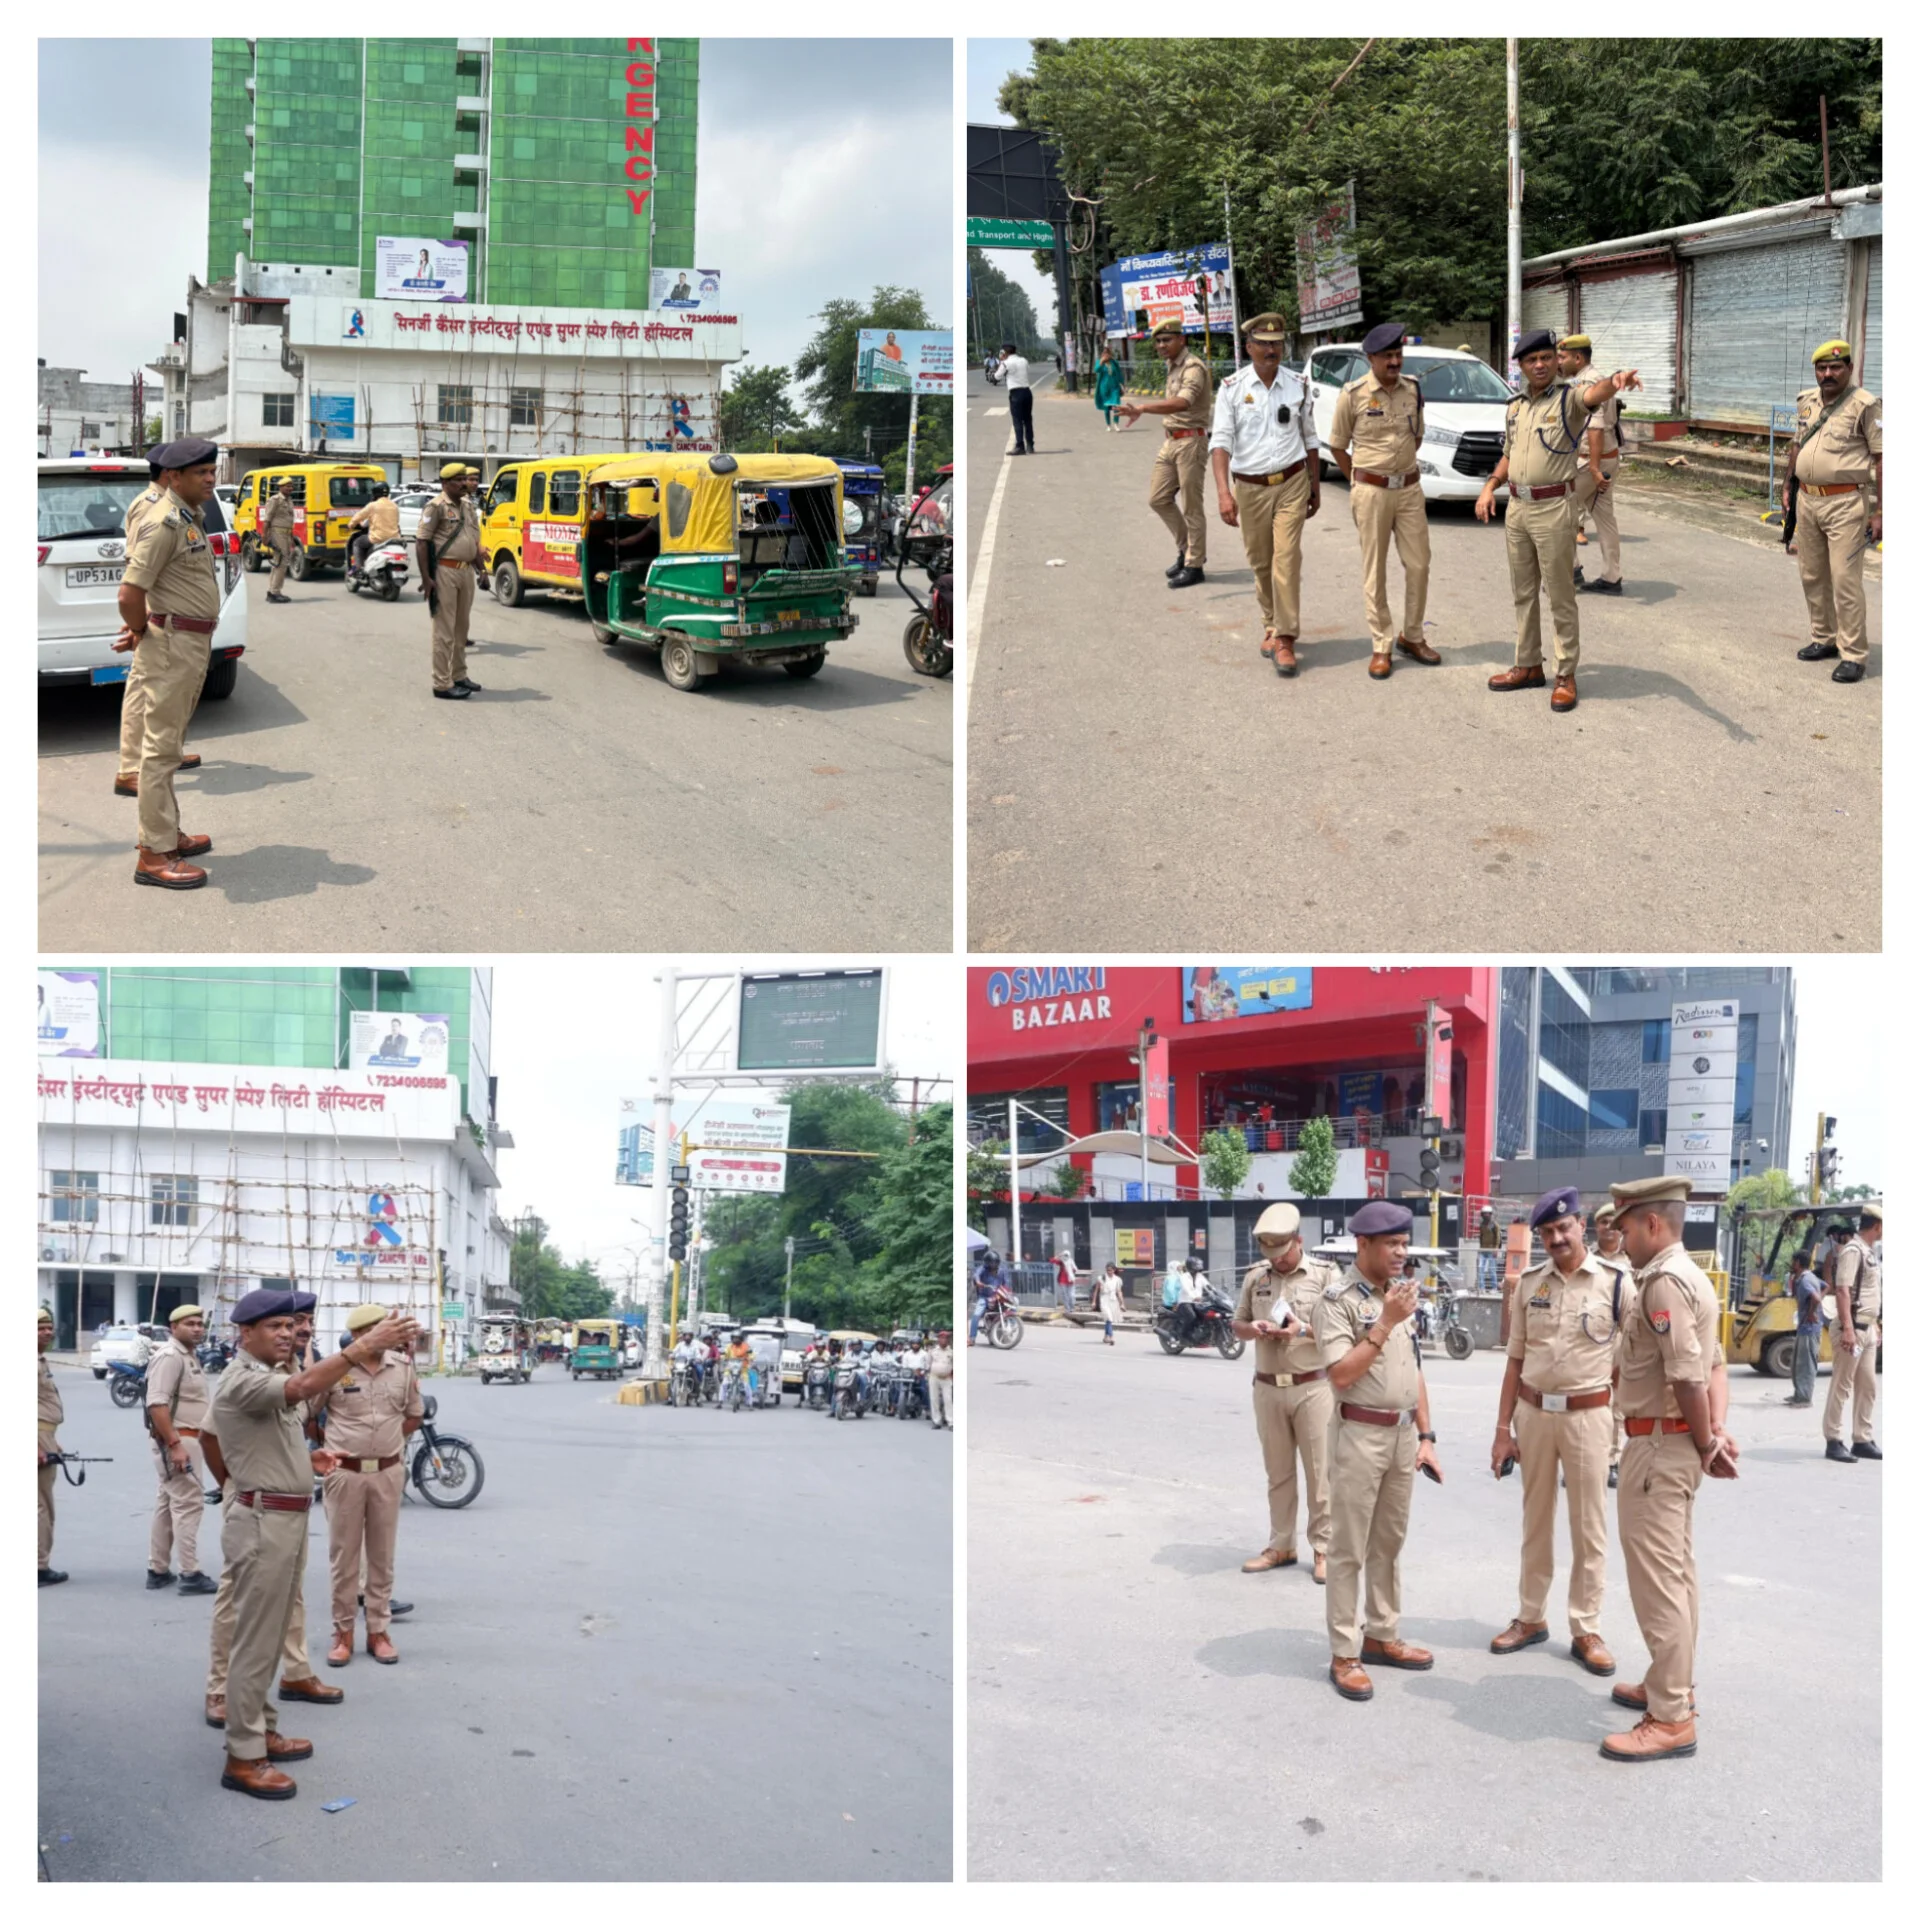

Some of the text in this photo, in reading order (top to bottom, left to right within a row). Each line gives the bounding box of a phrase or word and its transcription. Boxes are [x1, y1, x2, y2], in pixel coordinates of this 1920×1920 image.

[978, 230, 1015, 241] Transport
[394, 312, 432, 332] सिनर्जी
[435, 313, 466, 334] कैंसर
[555, 323, 582, 343] सुपर
[642, 322, 694, 342] हॉस्पिटल
[1012, 996, 1112, 1031] BAZAAR
[193, 1085, 229, 1112] सुपर
[316, 1085, 386, 1112] हॉस्पिटल
[1676, 1160, 1716, 1170] NILAYA
